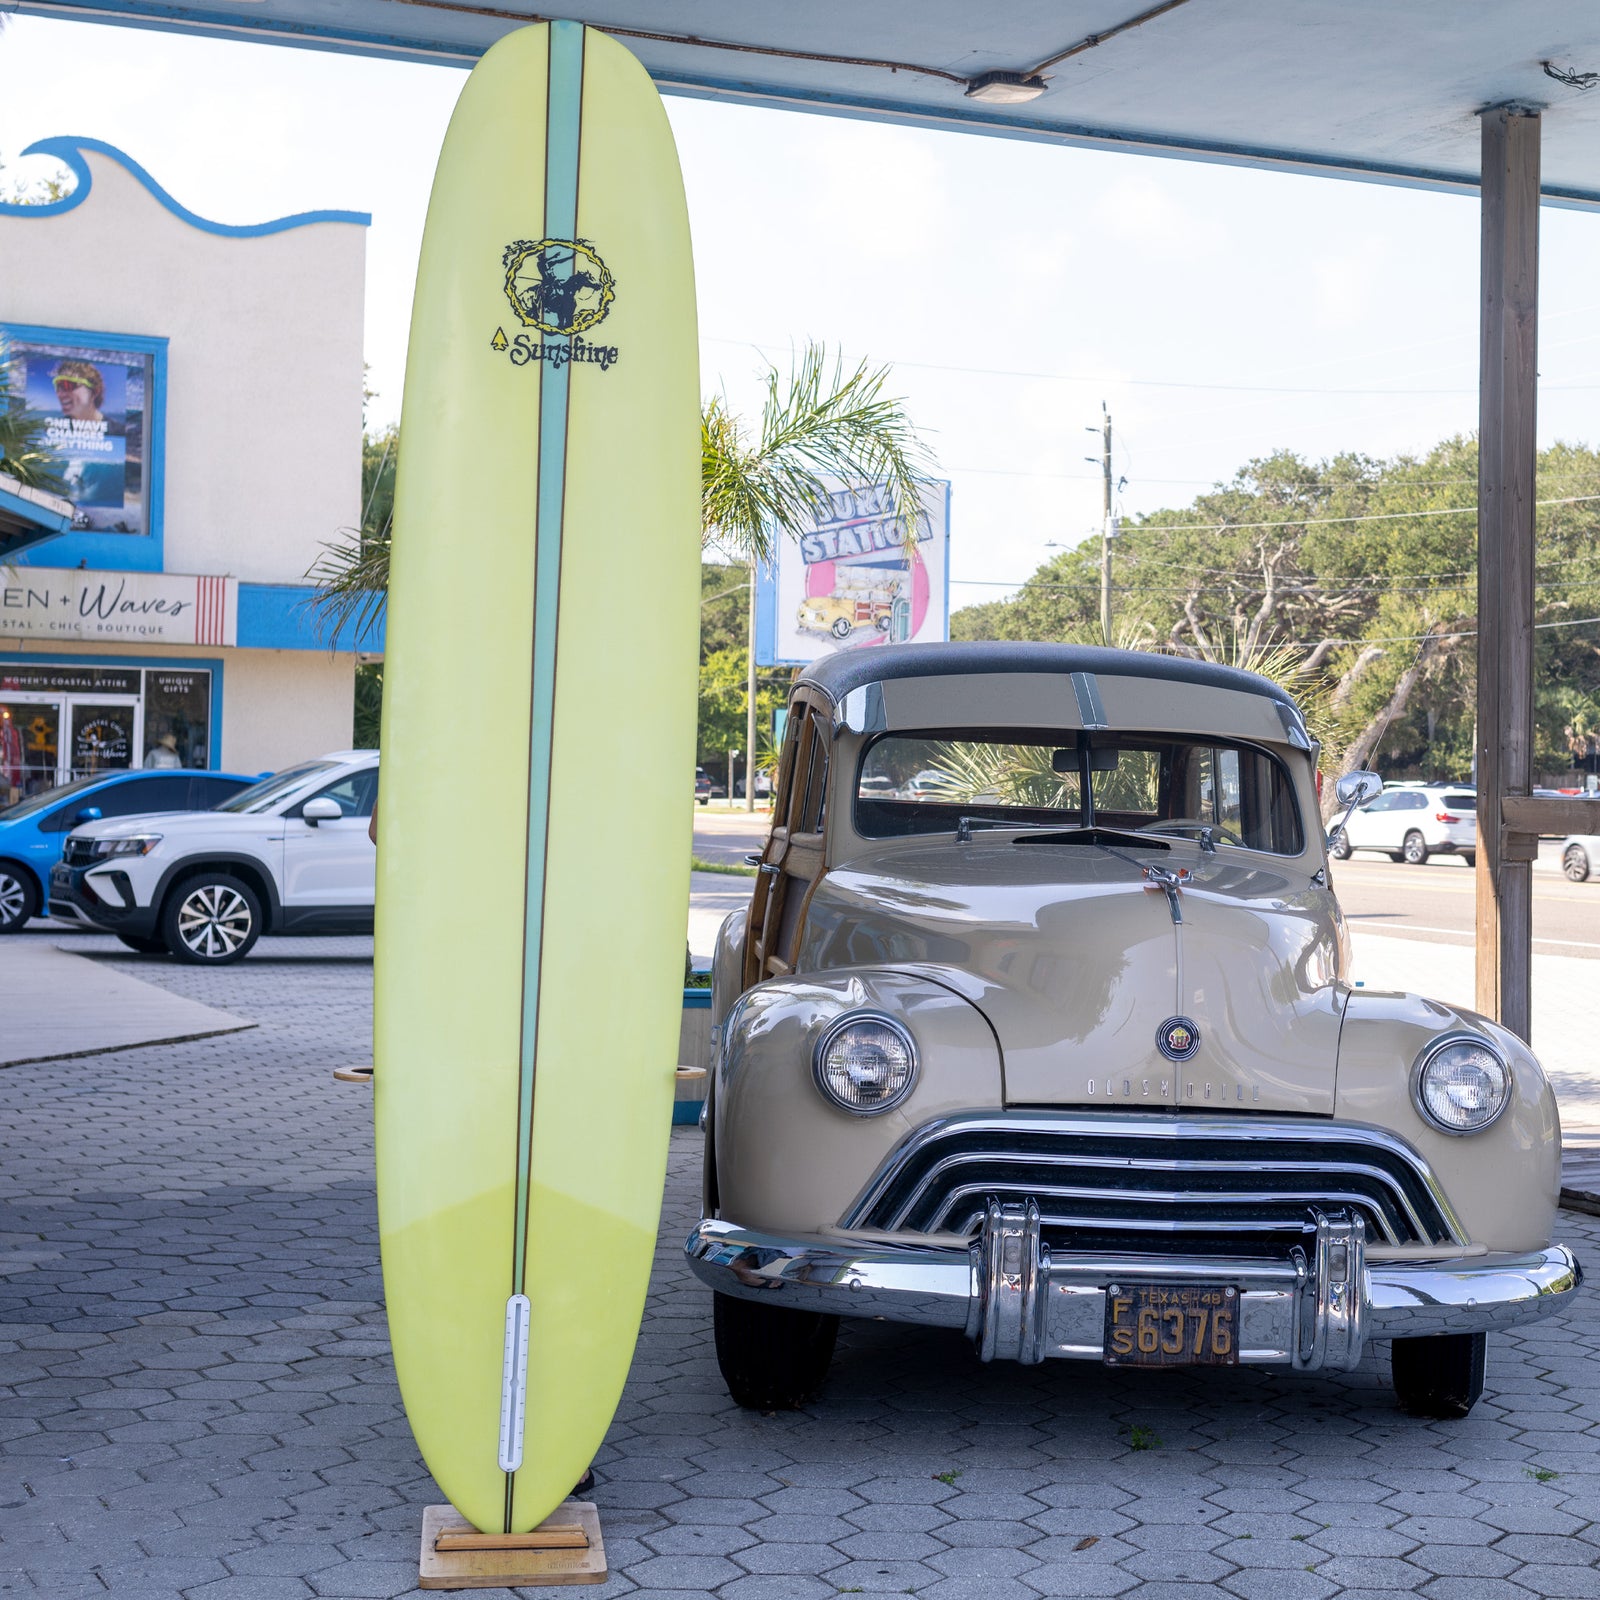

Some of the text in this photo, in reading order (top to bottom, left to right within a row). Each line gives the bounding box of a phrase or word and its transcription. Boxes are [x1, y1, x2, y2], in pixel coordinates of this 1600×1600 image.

[510, 334, 618, 371] Sunshine
[44, 416, 108, 432] ONE WAVE
[47, 427, 104, 442] CHANGES
[79, 577, 192, 619] Waves
[50, 621, 81, 632] CHIC
[97, 624, 164, 634] BOUTIQUE
[4, 676, 128, 688] WOMEN'S COASTAL ATTIRE
[159, 677, 193, 686] UNIQUE
[163, 685, 189, 693] GIFTS
[1087, 1078, 1260, 1102] OLDSMOBILE
[1138, 1308, 1232, 1355] 6376
